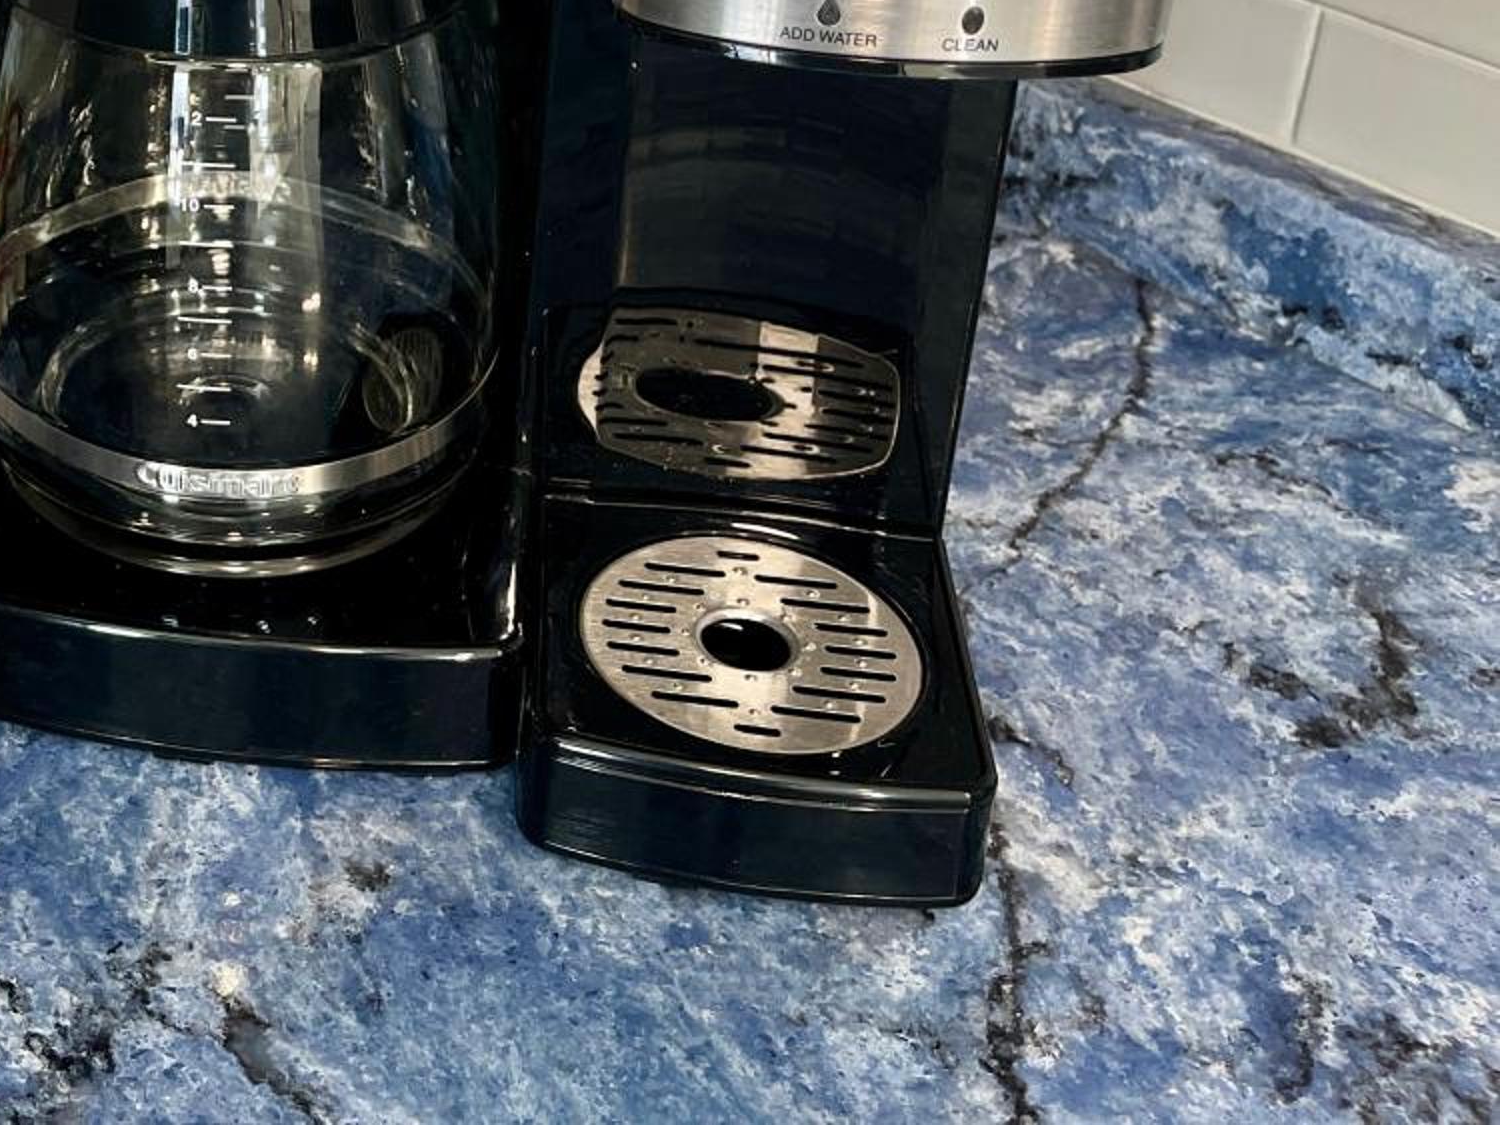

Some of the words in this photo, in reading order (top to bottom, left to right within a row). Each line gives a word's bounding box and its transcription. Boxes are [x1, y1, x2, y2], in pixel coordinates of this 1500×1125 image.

[779, 26, 815, 43] ADD
[819, 30, 878, 47] WATER
[941, 37, 999, 52] CLEAN
[186, 414, 198, 427] 4
